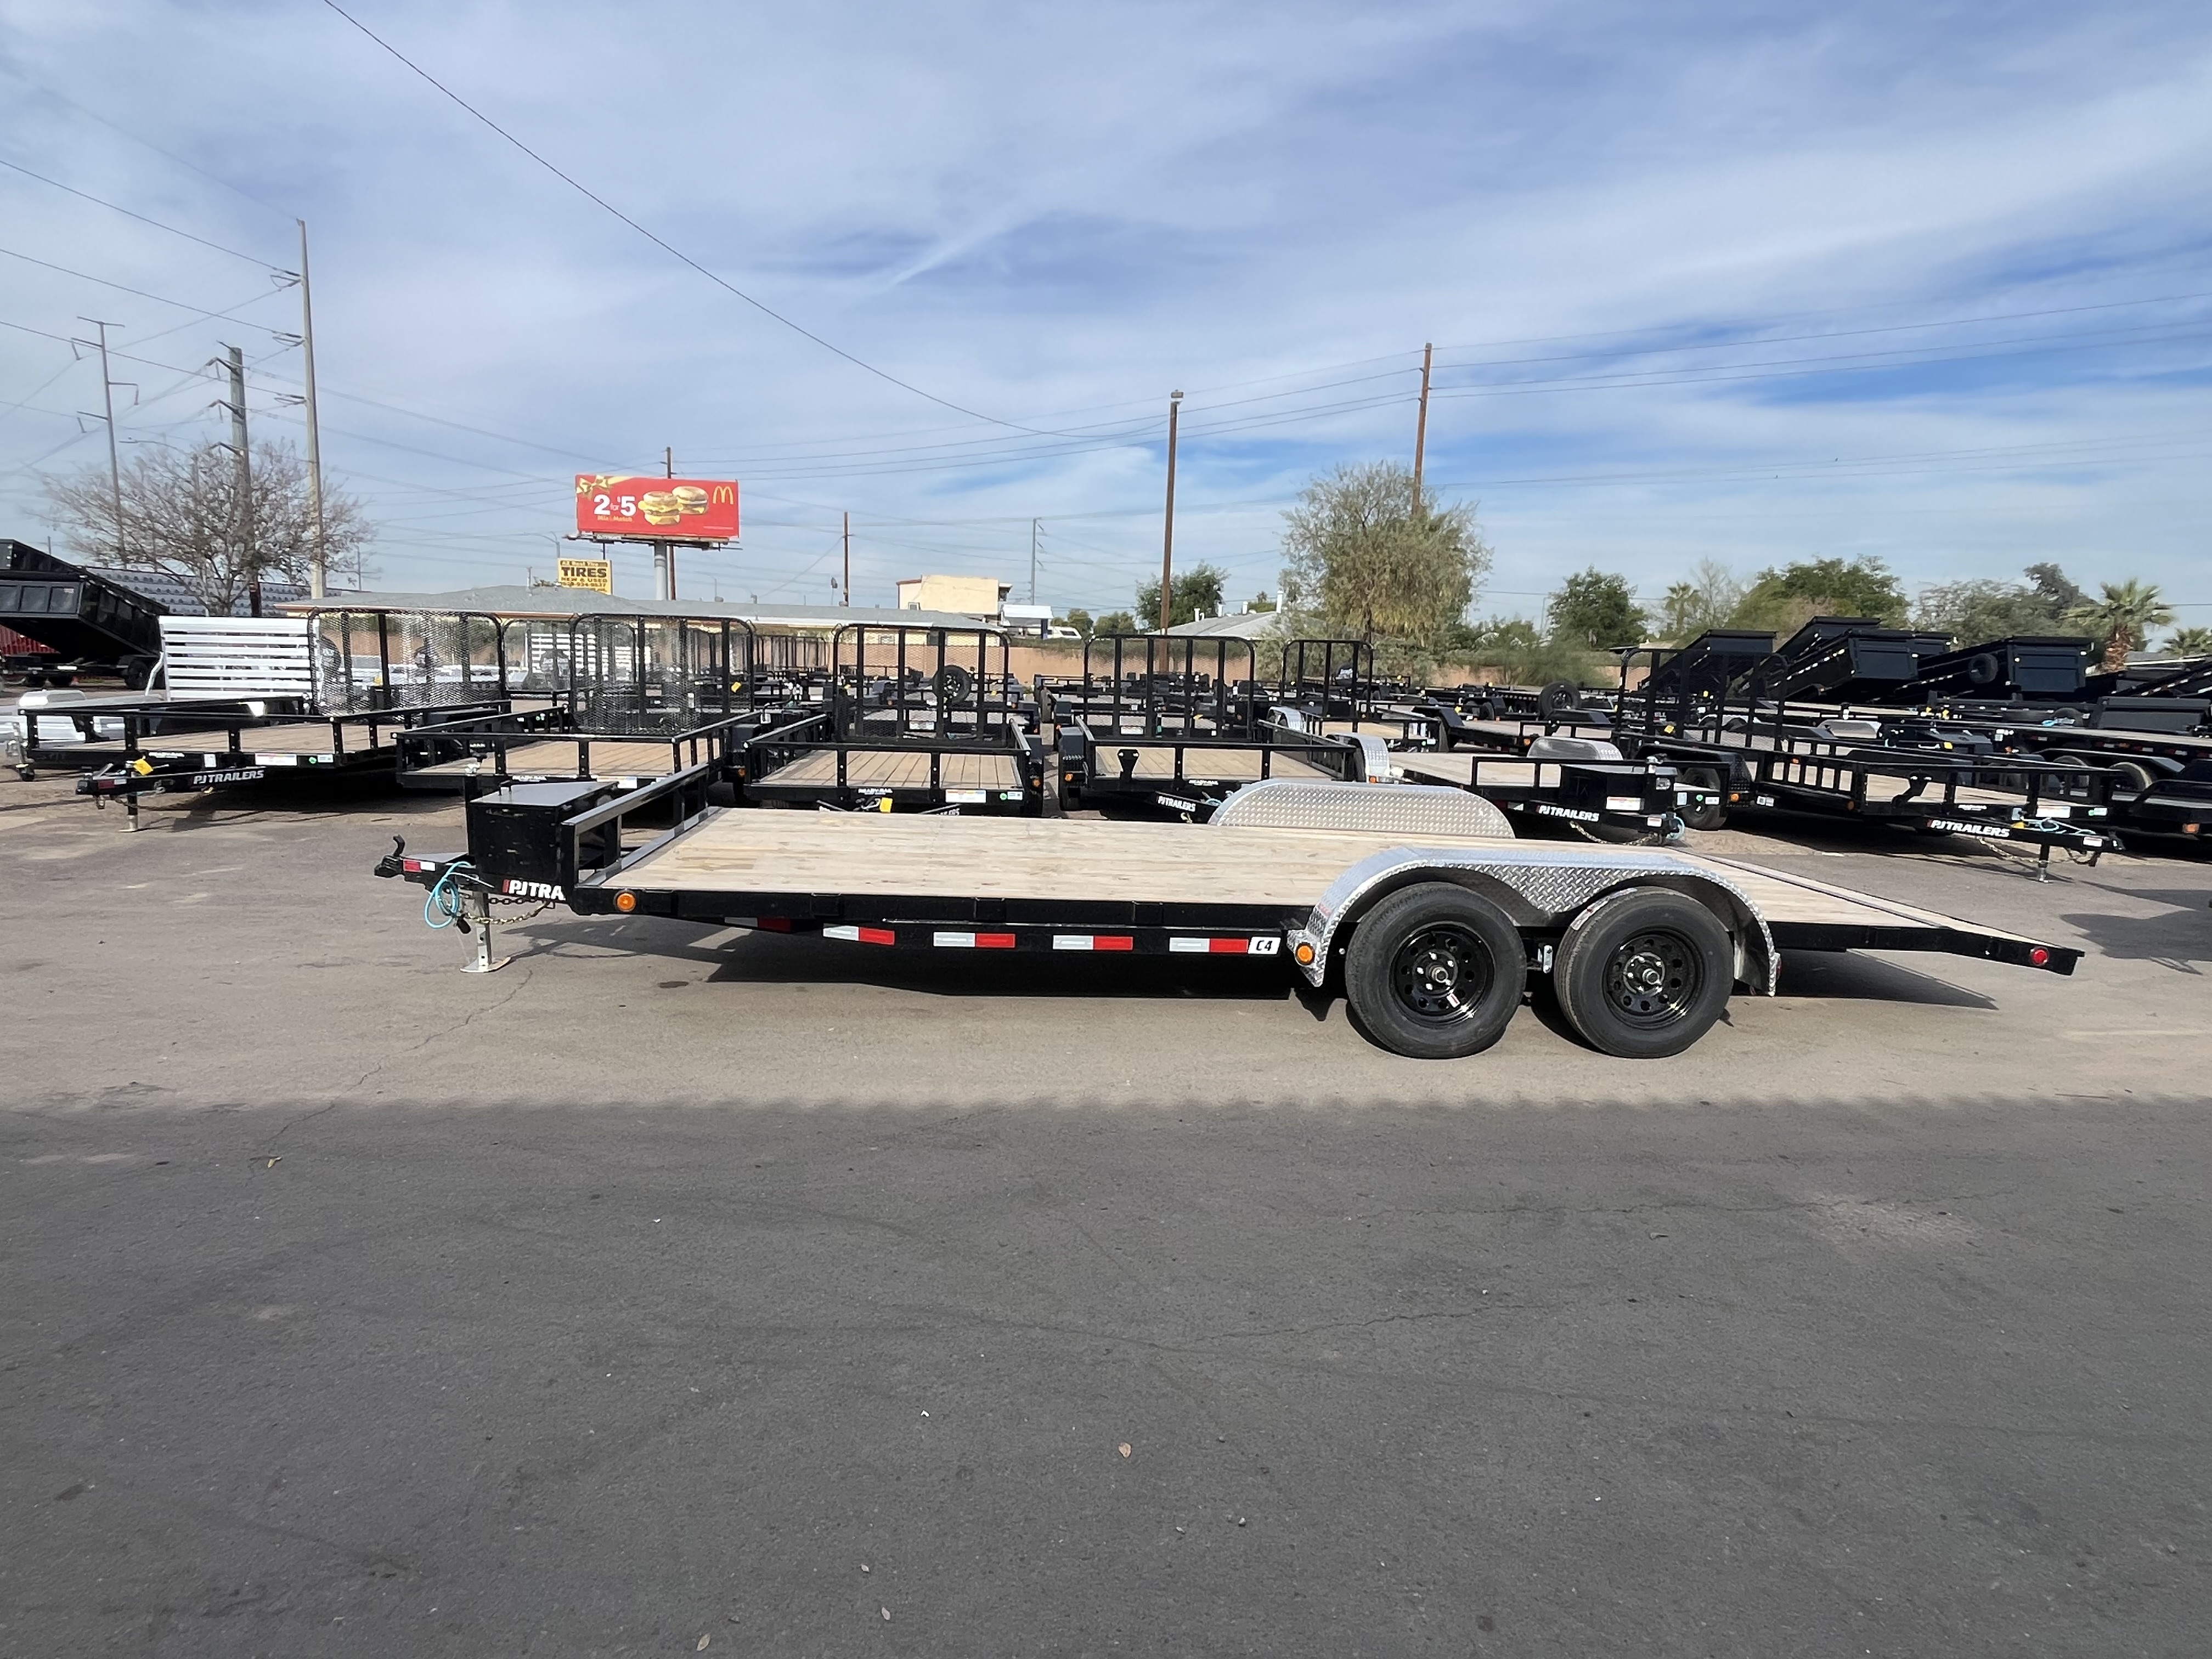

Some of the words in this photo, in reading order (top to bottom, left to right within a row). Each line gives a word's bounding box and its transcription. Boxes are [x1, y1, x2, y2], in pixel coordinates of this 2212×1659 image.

[594, 494, 611, 515] 2
[561, 567, 607, 578] TIRES
[1256, 940, 1273, 951] C4
